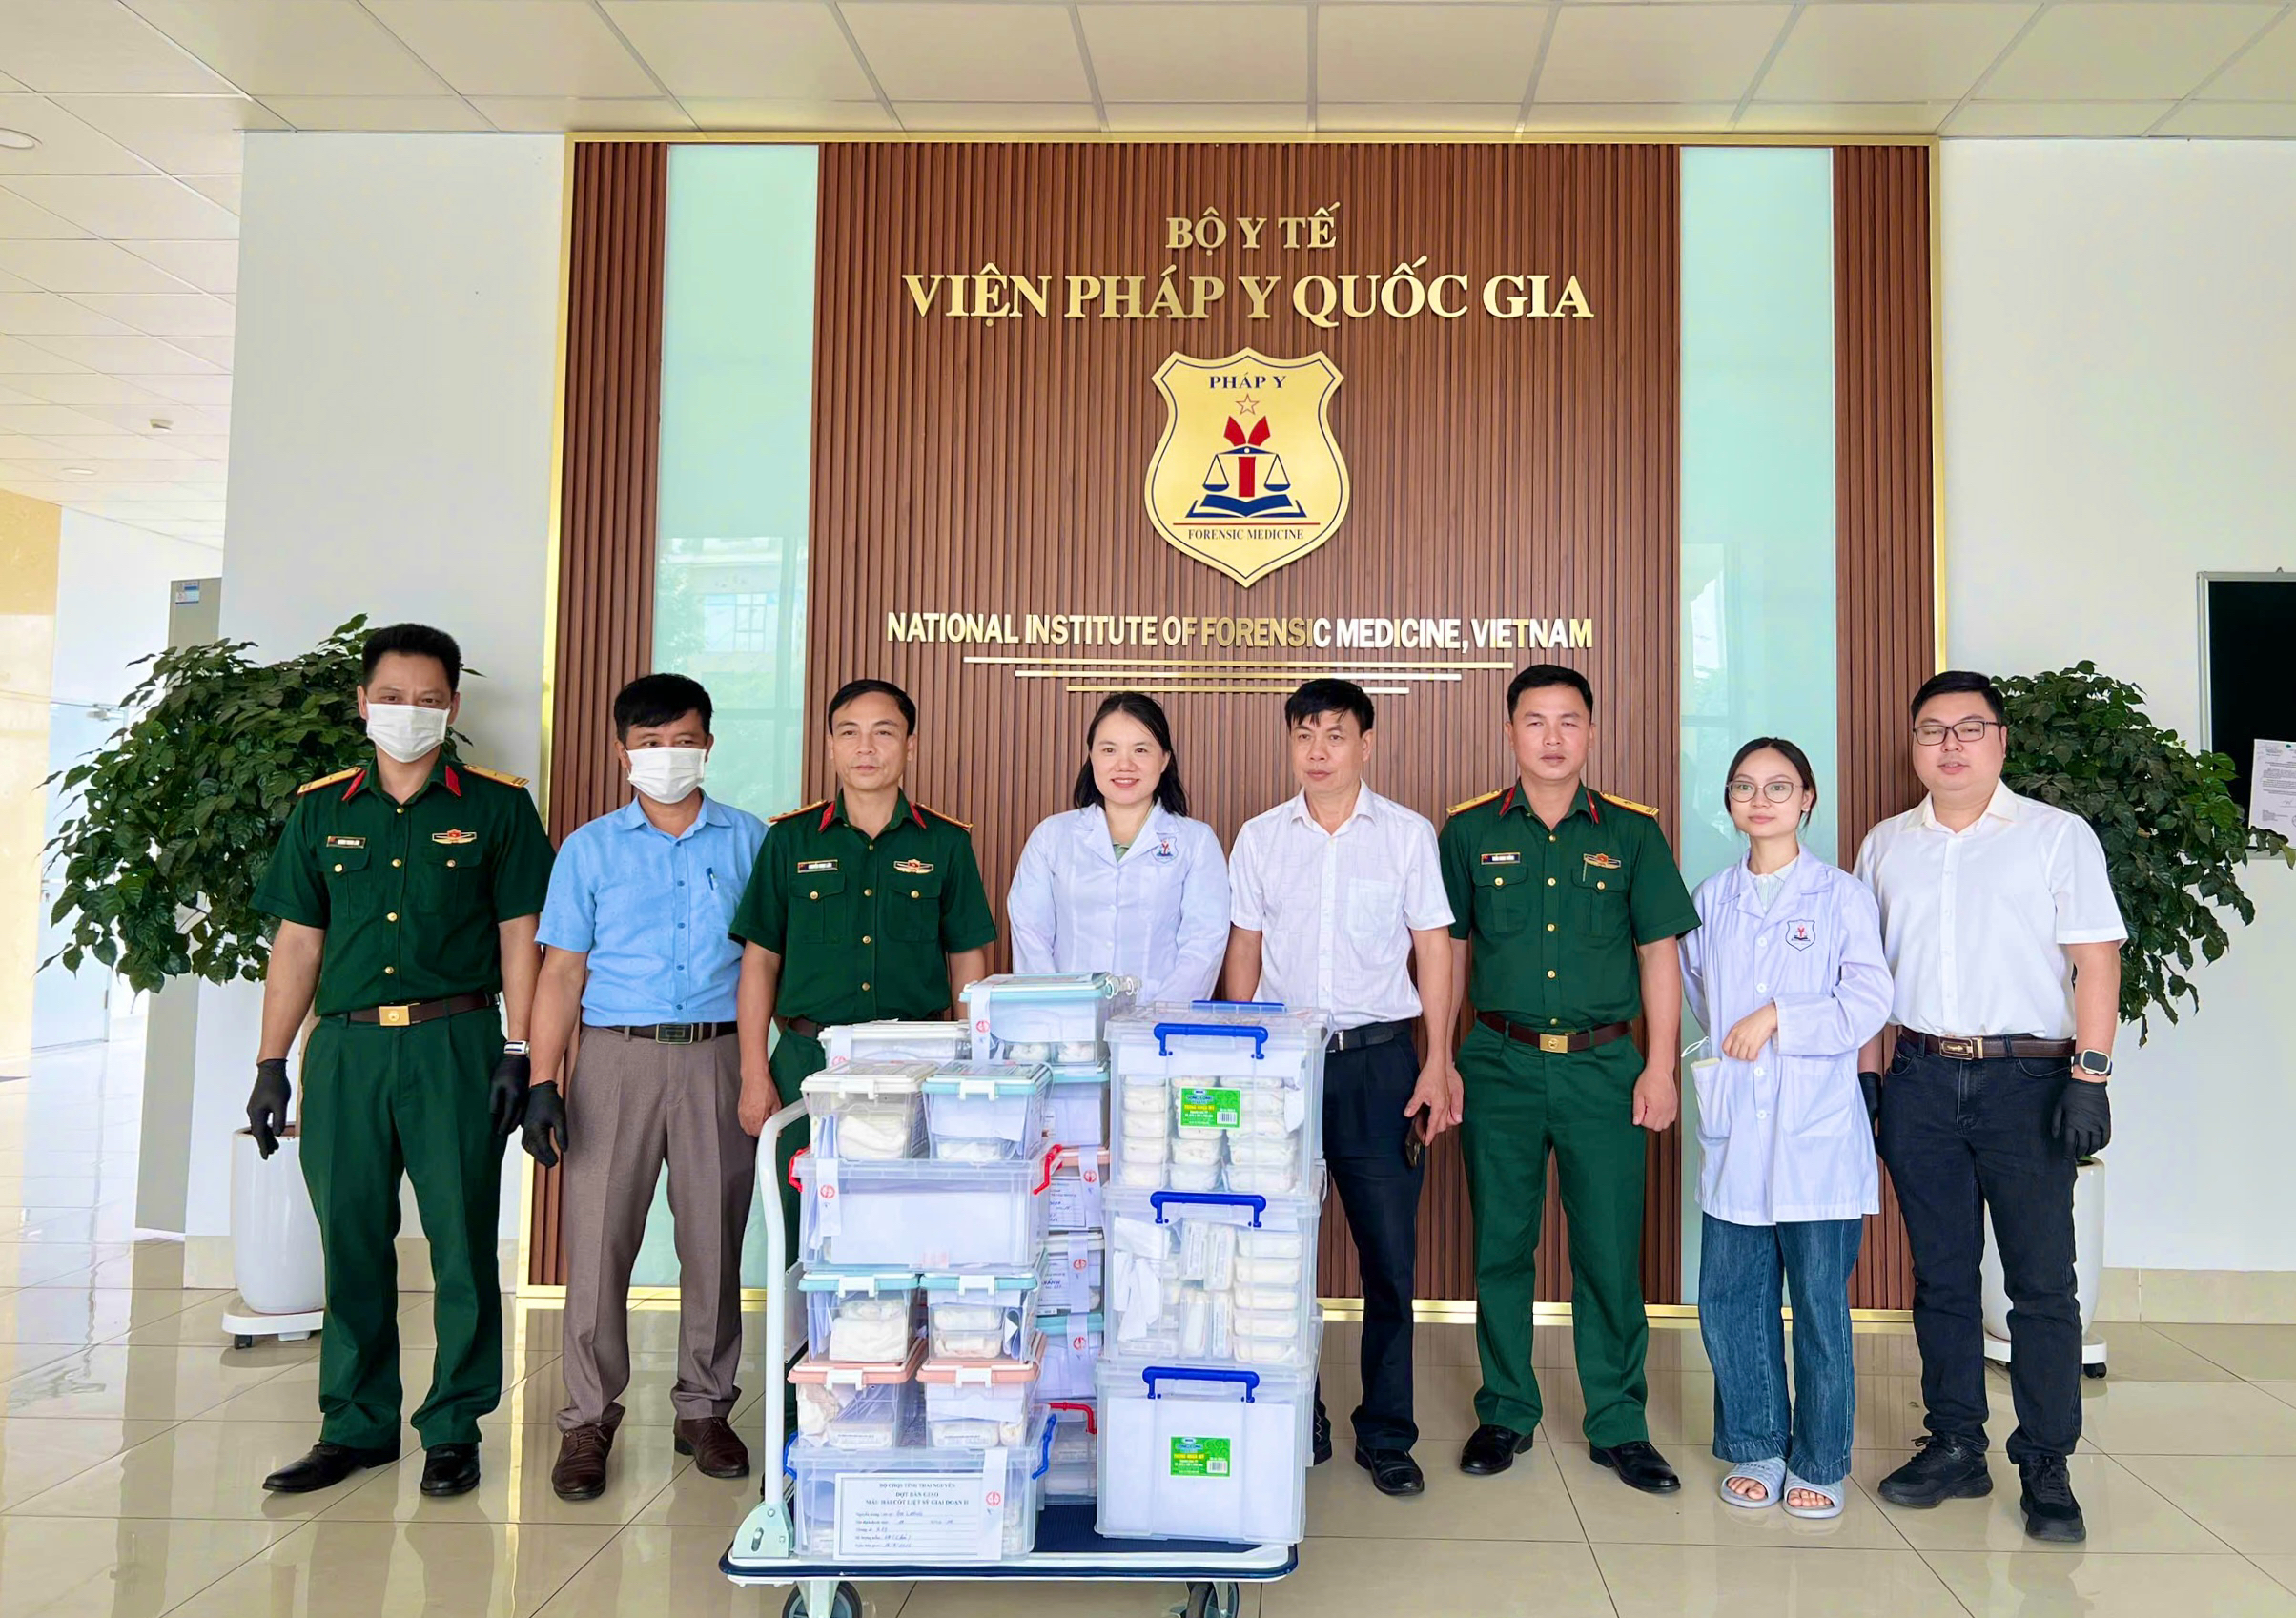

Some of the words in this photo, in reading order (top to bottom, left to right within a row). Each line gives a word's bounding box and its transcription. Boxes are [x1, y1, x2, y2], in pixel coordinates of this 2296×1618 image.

[1165, 206, 1227, 256] BỘ
[1236, 216, 1268, 250] Y
[1278, 201, 1342, 250] TẾ
[901, 262, 1053, 328] VIỆN
[1063, 264, 1226, 319] PHÁP
[1238, 275, 1281, 319] Y
[1292, 255, 1469, 329] QUỐC
[1482, 274, 1595, 319] GIA
[1209, 371, 1267, 389] PHÁP
[1272, 375, 1287, 389] Y
[1187, 528, 1244, 541] FORENSIC
[1246, 528, 1304, 541] MEDICINE
[887, 611, 1019, 645] NATIONAL
[1024, 613, 1158, 646] INSTITUTE
[1161, 615, 1198, 646] OF
[1200, 617, 1332, 648] FORENSIC
[1336, 617, 1469, 654] MEDICINE,
[1470, 618, 1593, 649] VIETNAM
